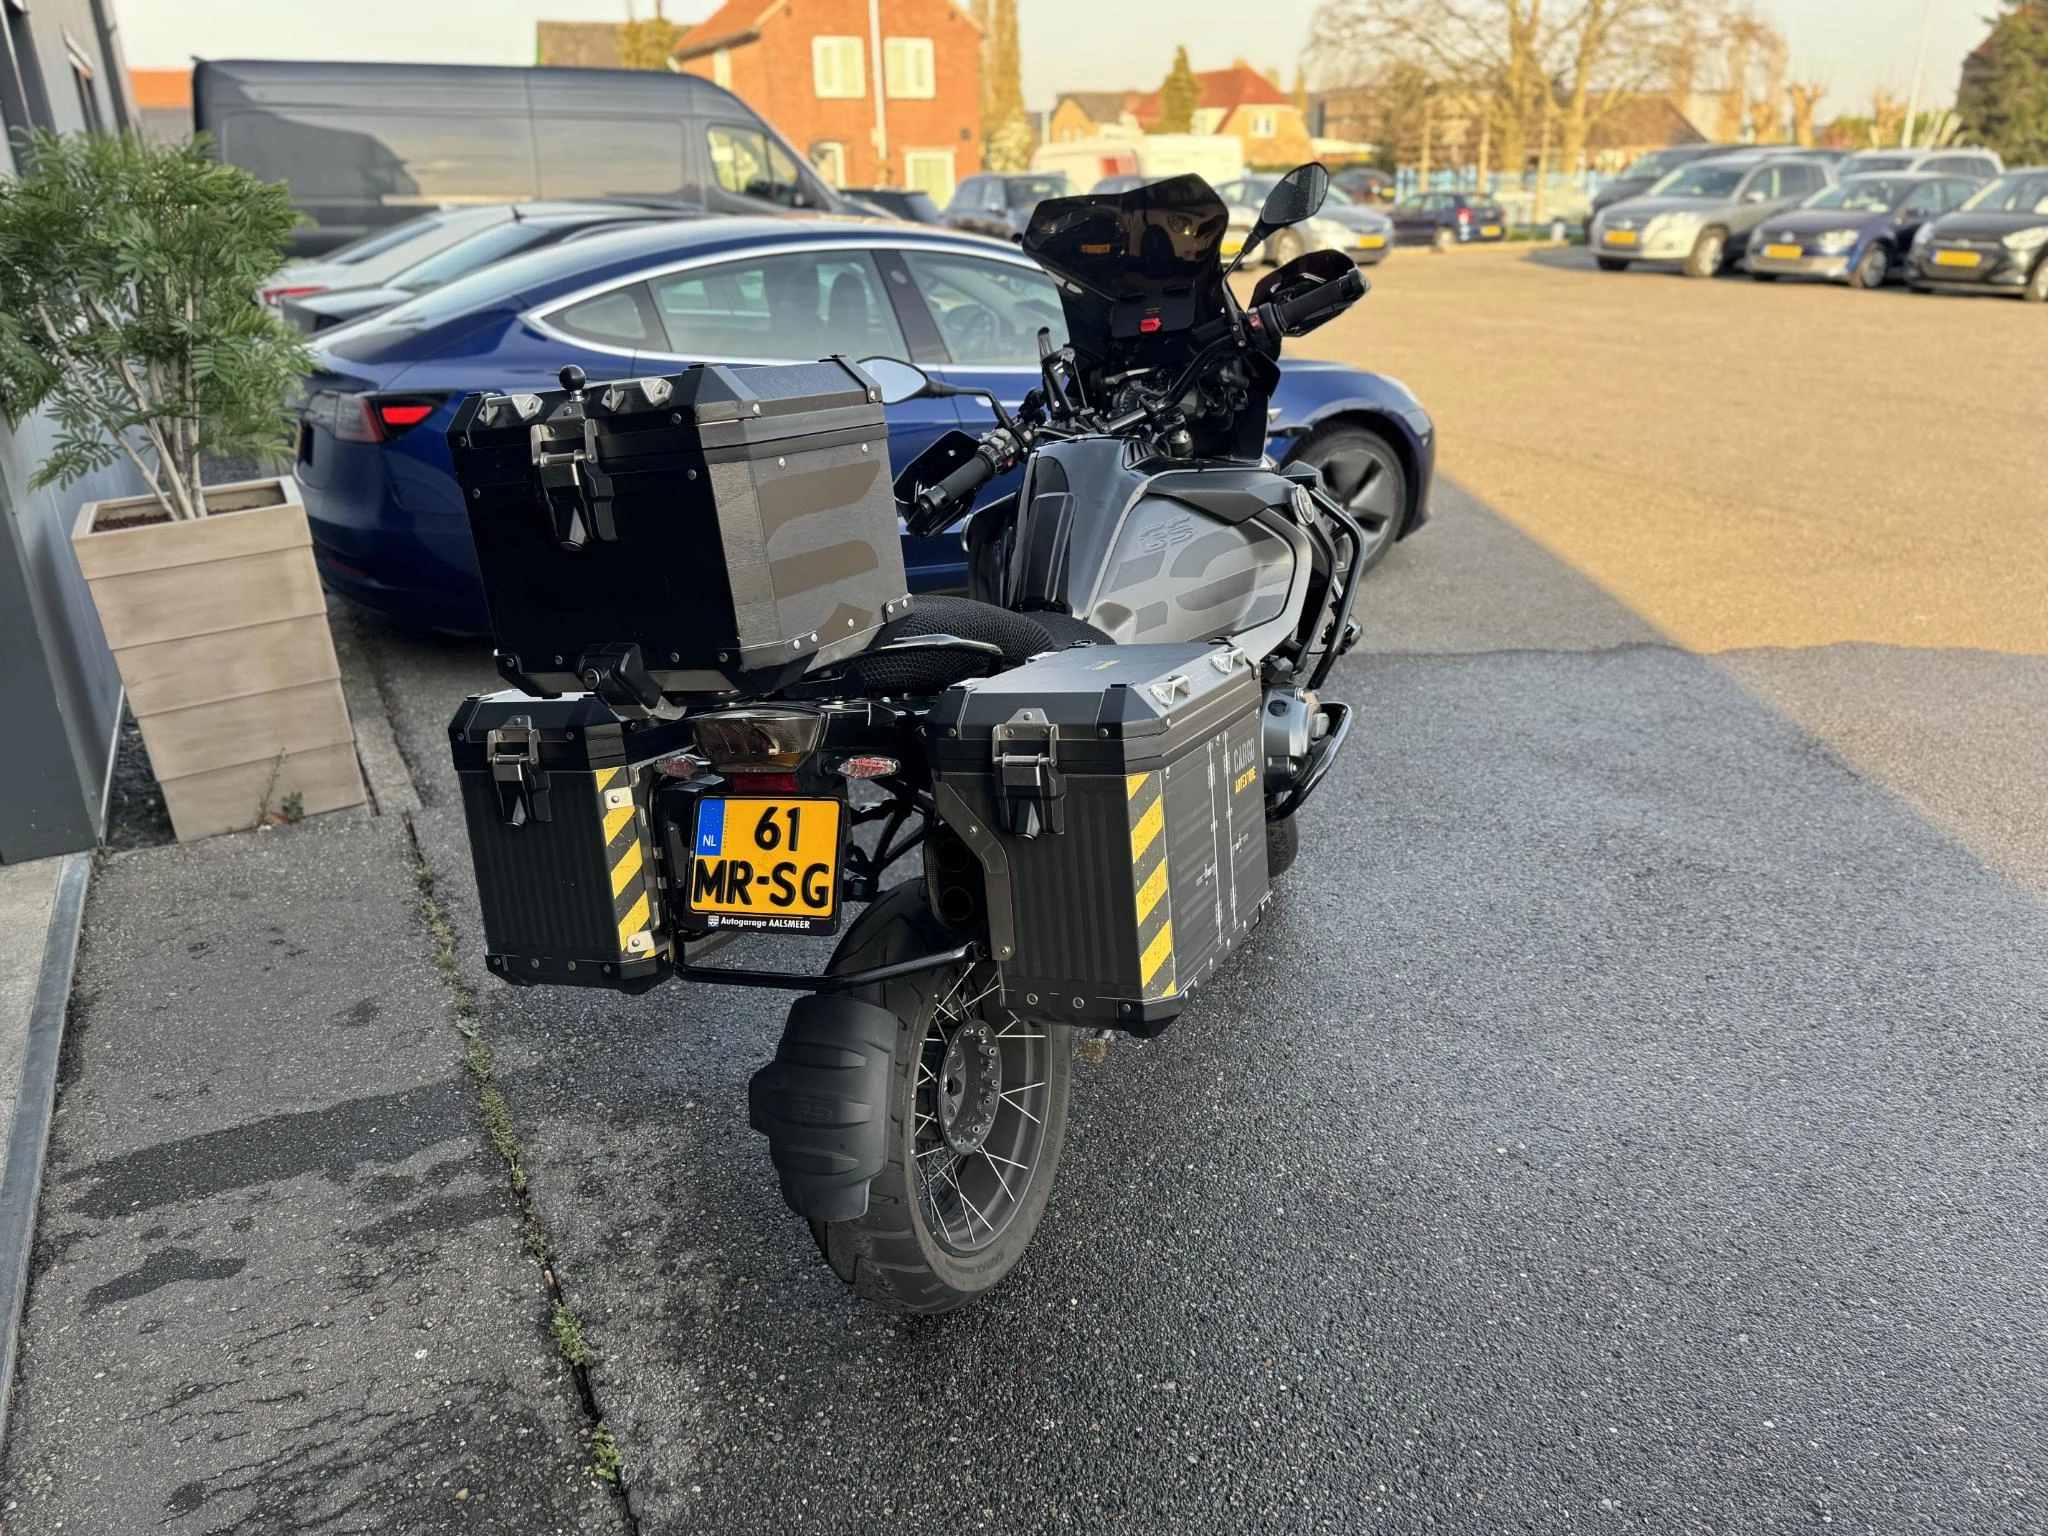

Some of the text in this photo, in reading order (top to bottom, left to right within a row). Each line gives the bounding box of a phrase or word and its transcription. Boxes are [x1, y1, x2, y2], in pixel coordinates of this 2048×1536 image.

[1233, 737, 1255, 774] CARGO
[702, 834, 717, 847] NL
[754, 806, 800, 851] 61
[693, 859, 829, 908] MR-SG
[721, 916, 810, 929] Autogarage AALSMEER
